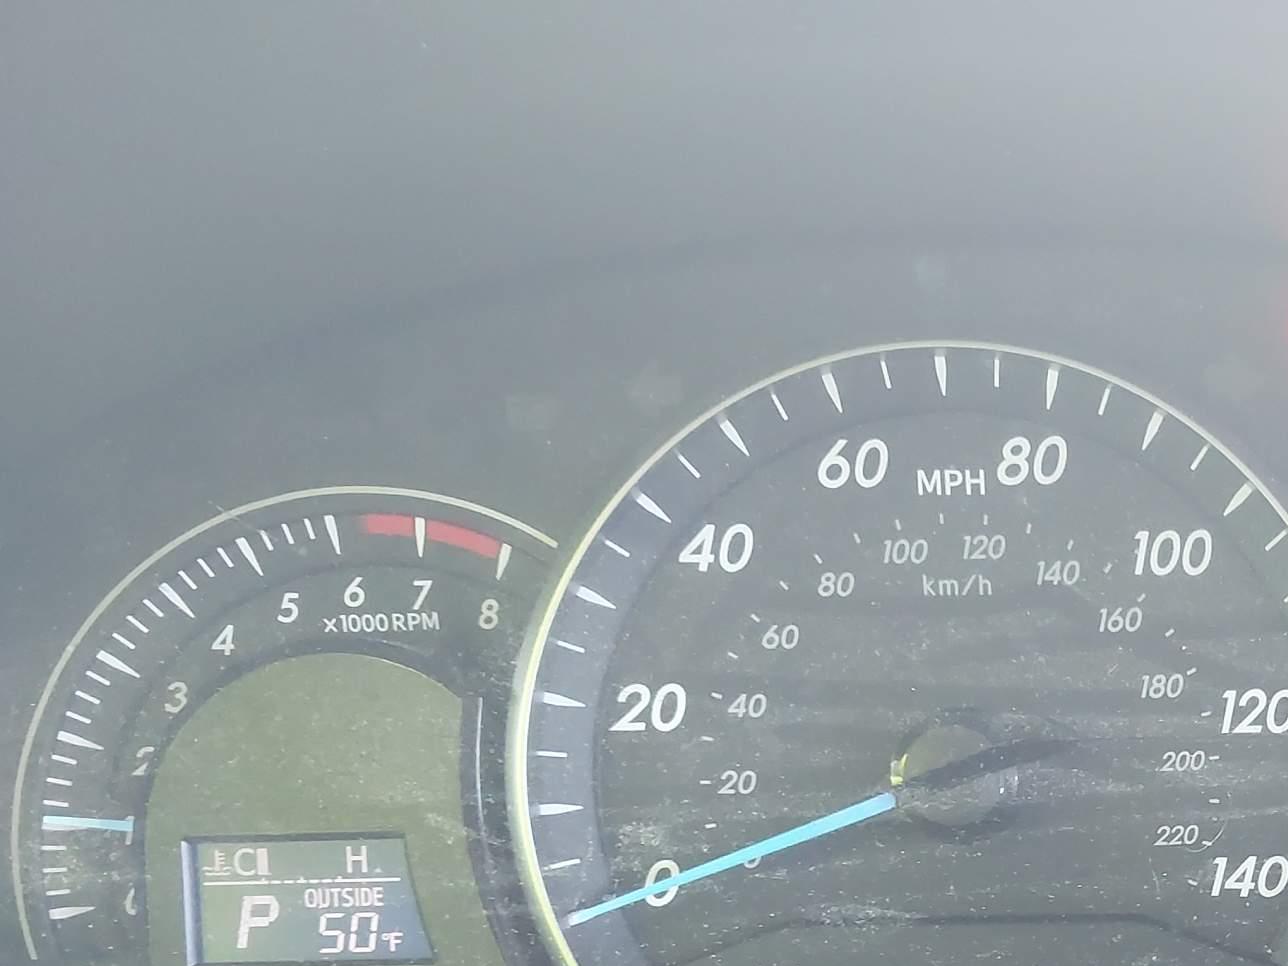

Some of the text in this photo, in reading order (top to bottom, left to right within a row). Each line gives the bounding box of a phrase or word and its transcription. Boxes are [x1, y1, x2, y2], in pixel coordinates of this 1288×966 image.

[816, 438, 889, 490] 60
[996, 434, 1068, 486] 80
[915, 468, 987, 496] MPH
[678, 523, 755, 573] 40
[882, 538, 929, 565] 100
[961, 534, 1007, 560] 120
[1132, 528, 1213, 576] 100
[817, 571, 855, 598] 80
[921, 574, 993, 598] km/h
[1035, 560, 1081, 586] 140
[343, 576, 366, 608] 6
[412, 579, 433, 611] 7
[277, 592, 300, 624] 5
[478, 598, 500, 630] 8
[1099, 607, 1143, 633] 160
[211, 625, 235, 656] 4
[760, 624, 800, 651] 60
[164, 682, 188, 714] 3
[1139, 673, 1185, 700] 180
[609, 682, 688, 733] 20
[727, 693, 768, 720] 40
[1160, 749, 1206, 773] 200
[717, 770, 757, 796] 20
[1153, 823, 1199, 846] 220
[345, 845, 369, 874] H
[303, 886, 386, 908] OUTSIDE
[643, 859, 681, 908] 0
[236, 895, 281, 949] P
